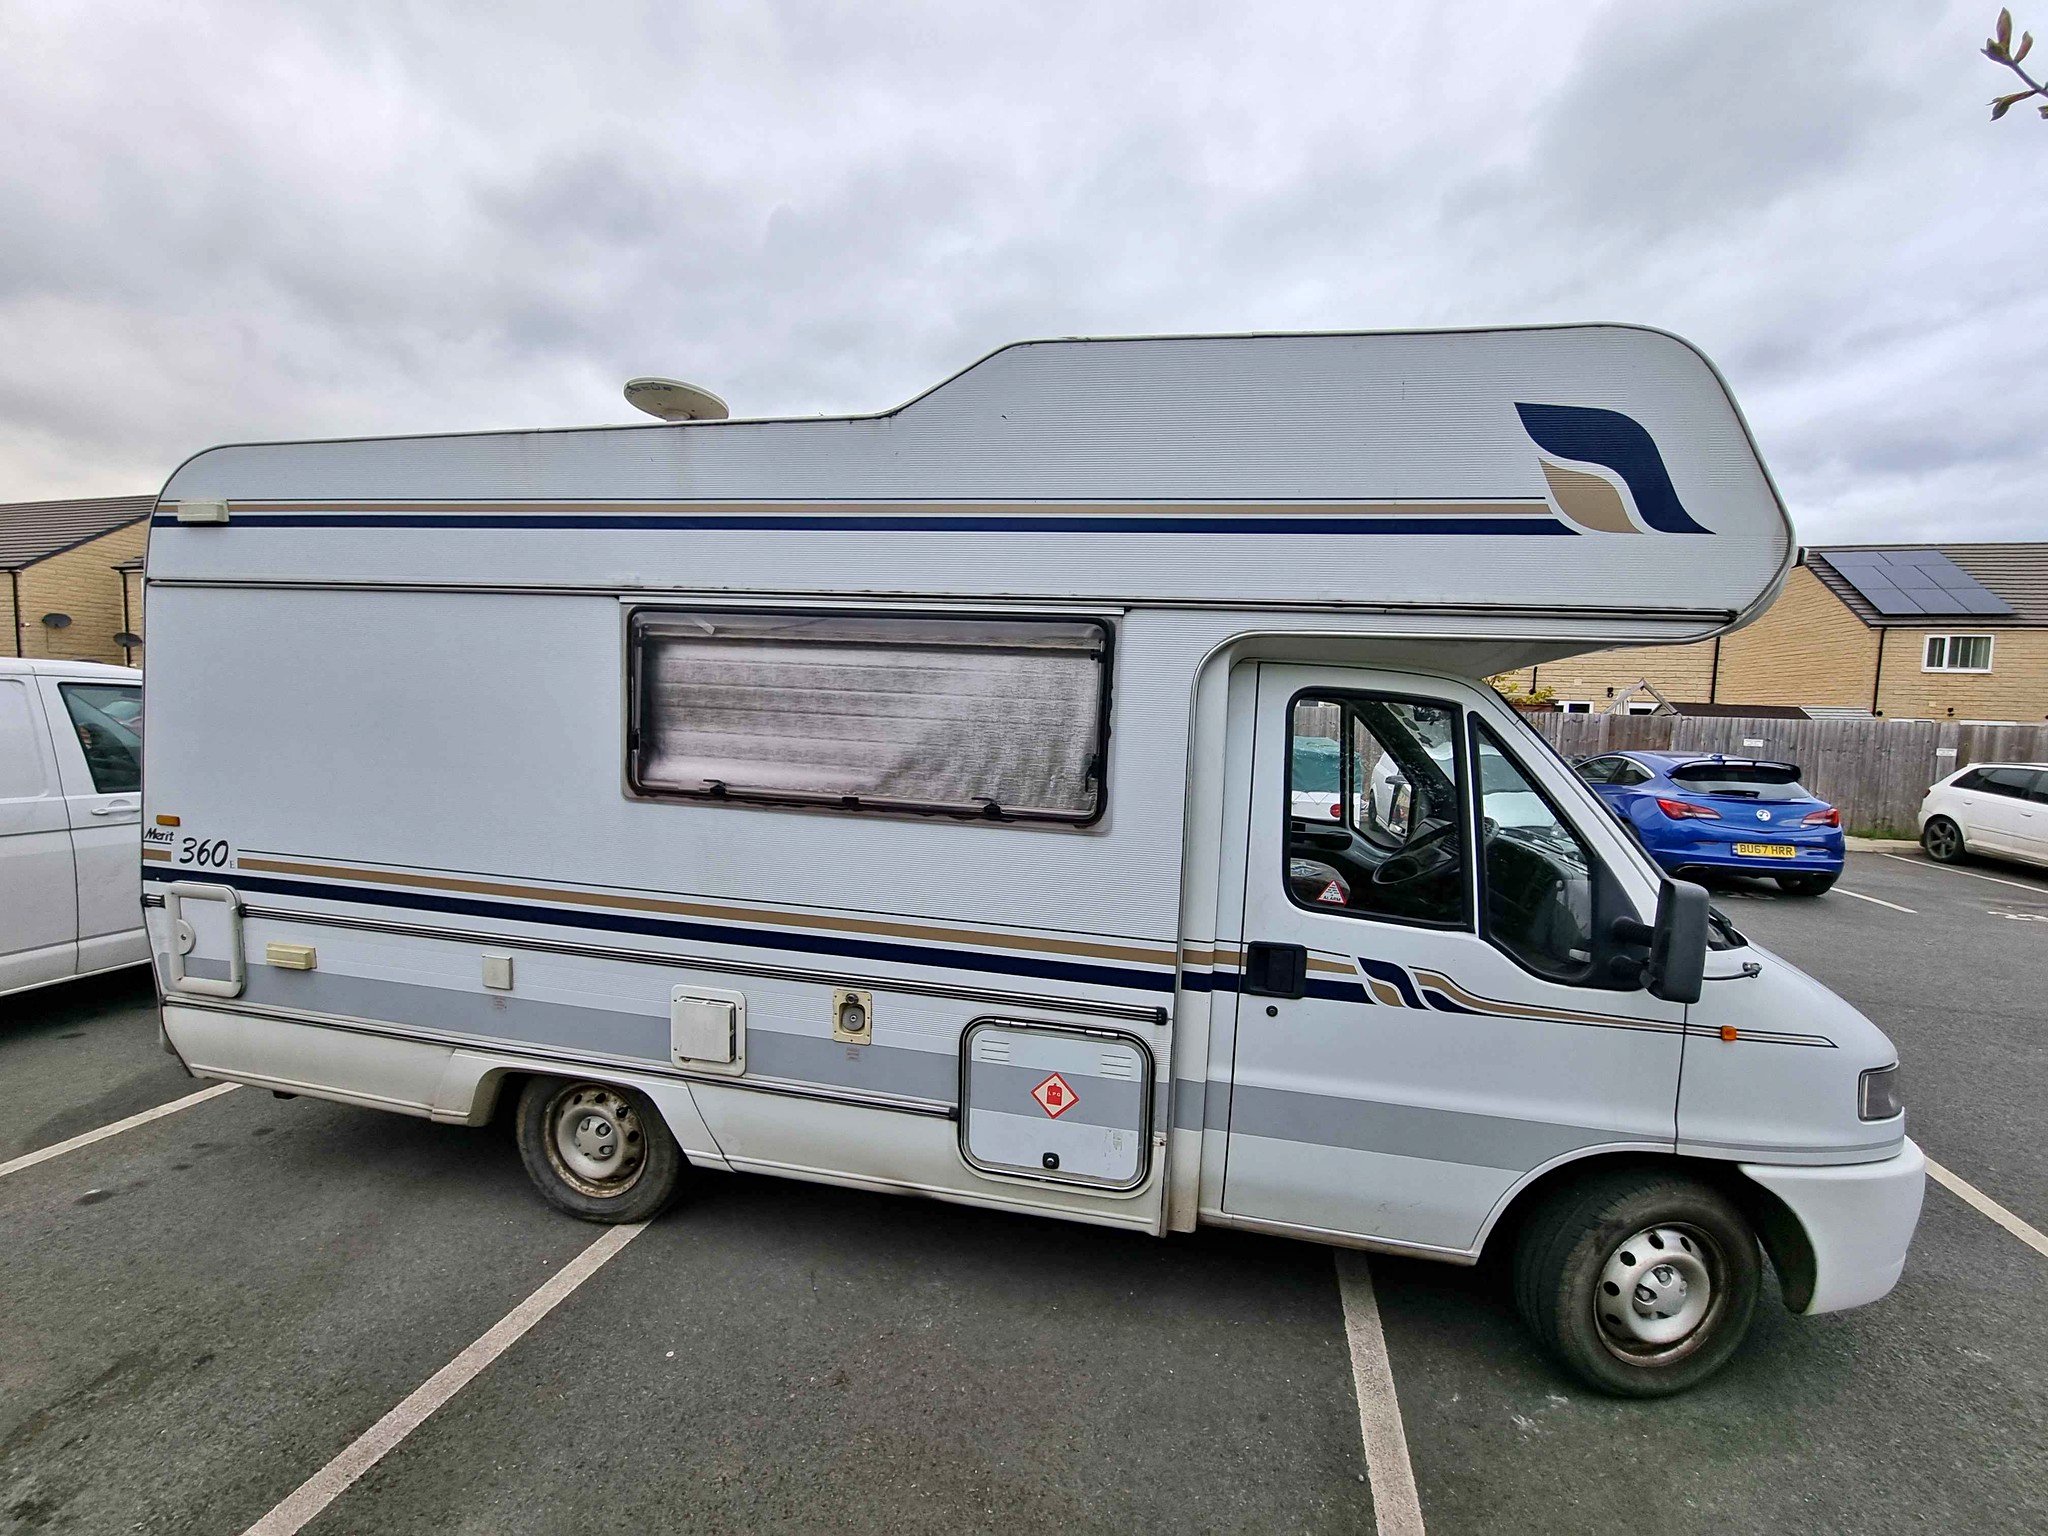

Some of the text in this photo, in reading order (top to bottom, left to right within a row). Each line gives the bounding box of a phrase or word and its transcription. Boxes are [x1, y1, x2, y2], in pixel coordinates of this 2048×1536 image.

[144, 827, 175, 842] Merit
[179, 837, 229, 867] 360
[1740, 844, 1793, 856] BU67 HRR
